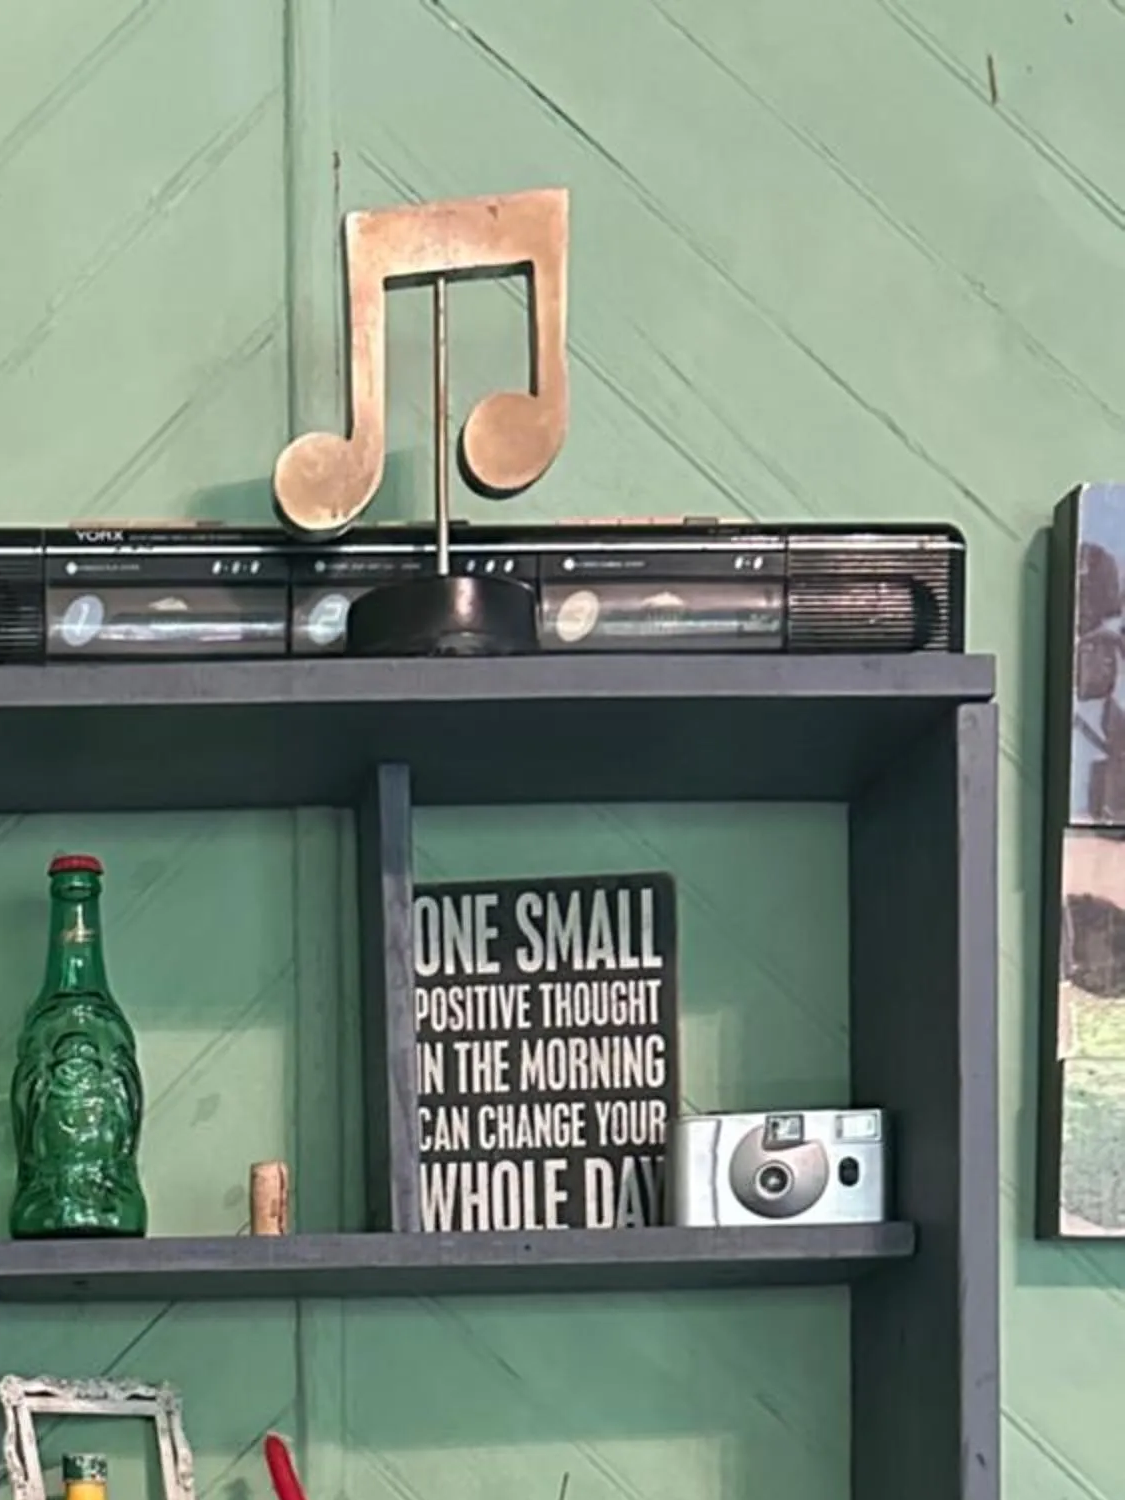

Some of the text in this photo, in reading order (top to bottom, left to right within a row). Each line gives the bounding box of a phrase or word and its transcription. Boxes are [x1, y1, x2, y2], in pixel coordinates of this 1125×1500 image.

[415, 887, 663, 977] ONE SMALL
[415, 979, 663, 1033] POSITIVE THOUGHT
[416, 1034, 666, 1094] IN THE MORNING
[418, 1099, 668, 1152] CAN CHANGE YOUR
[420, 1155, 666, 1233] WHOLE DAY
